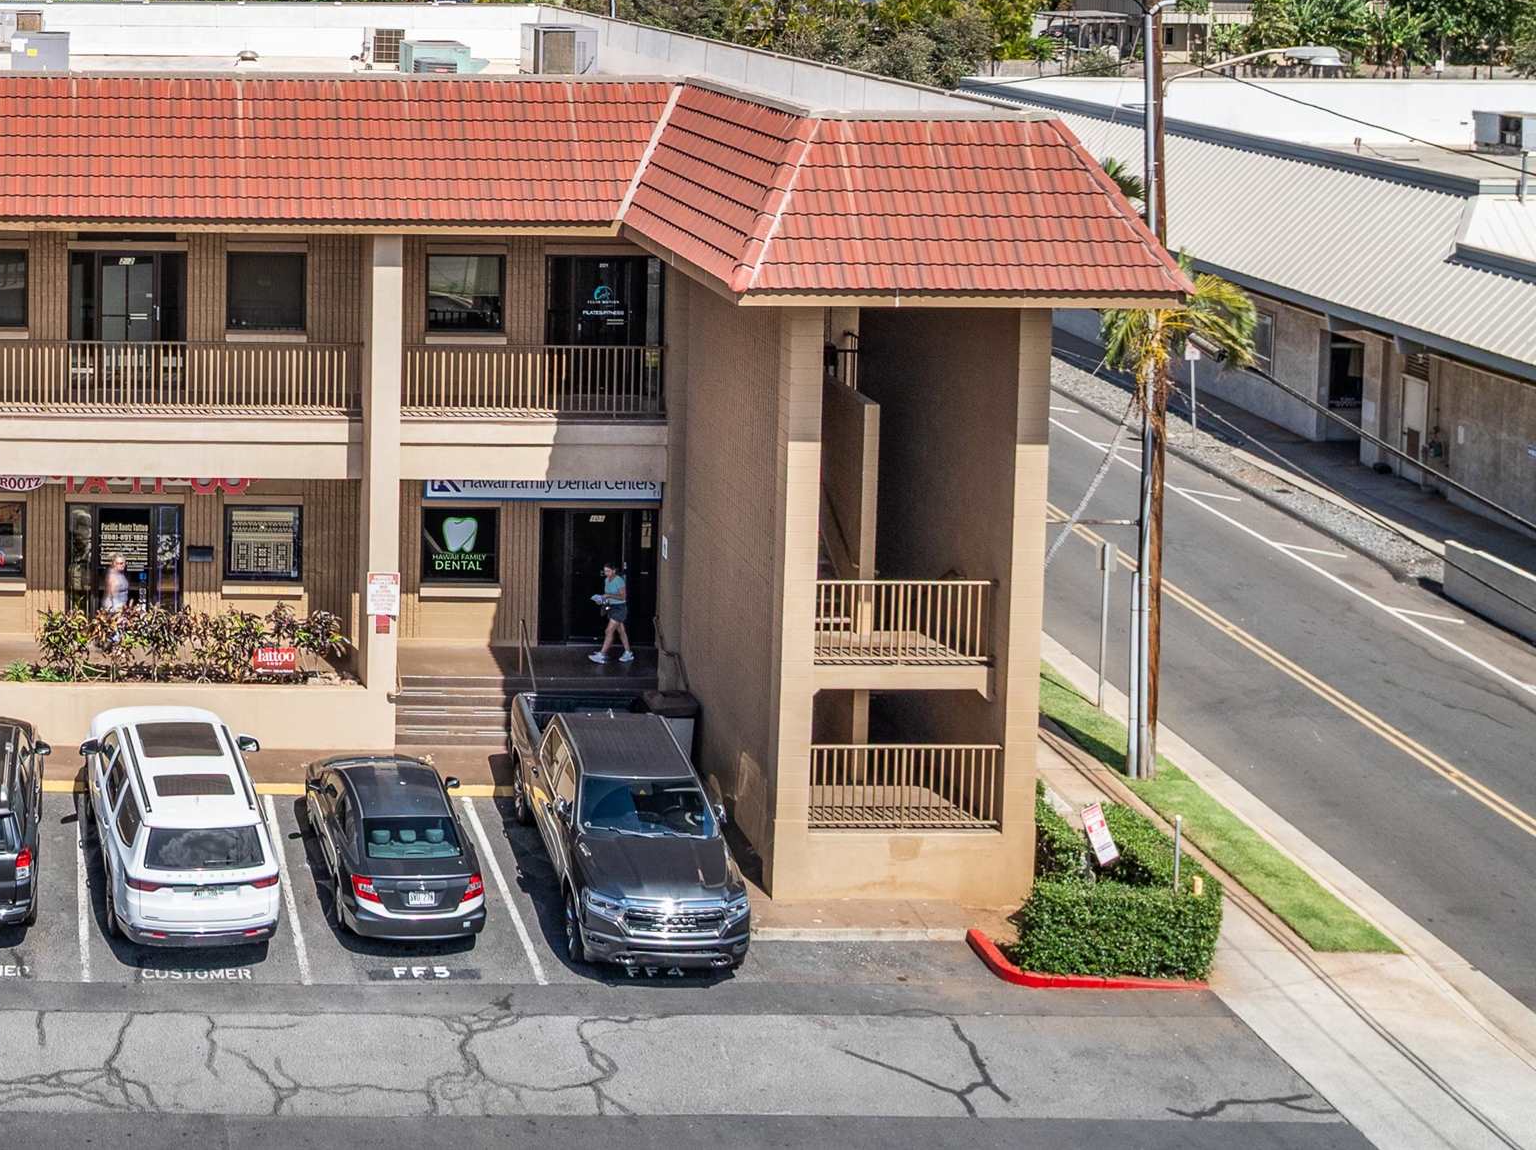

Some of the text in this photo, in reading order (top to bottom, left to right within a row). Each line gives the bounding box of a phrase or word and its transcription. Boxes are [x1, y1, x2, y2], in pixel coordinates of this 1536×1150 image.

[0, 476, 42, 490] ROOTZ
[435, 561, 483, 570] DENTAL
[256, 649, 295, 662] Tattoo
[141, 967, 252, 980] CUSTOMER
